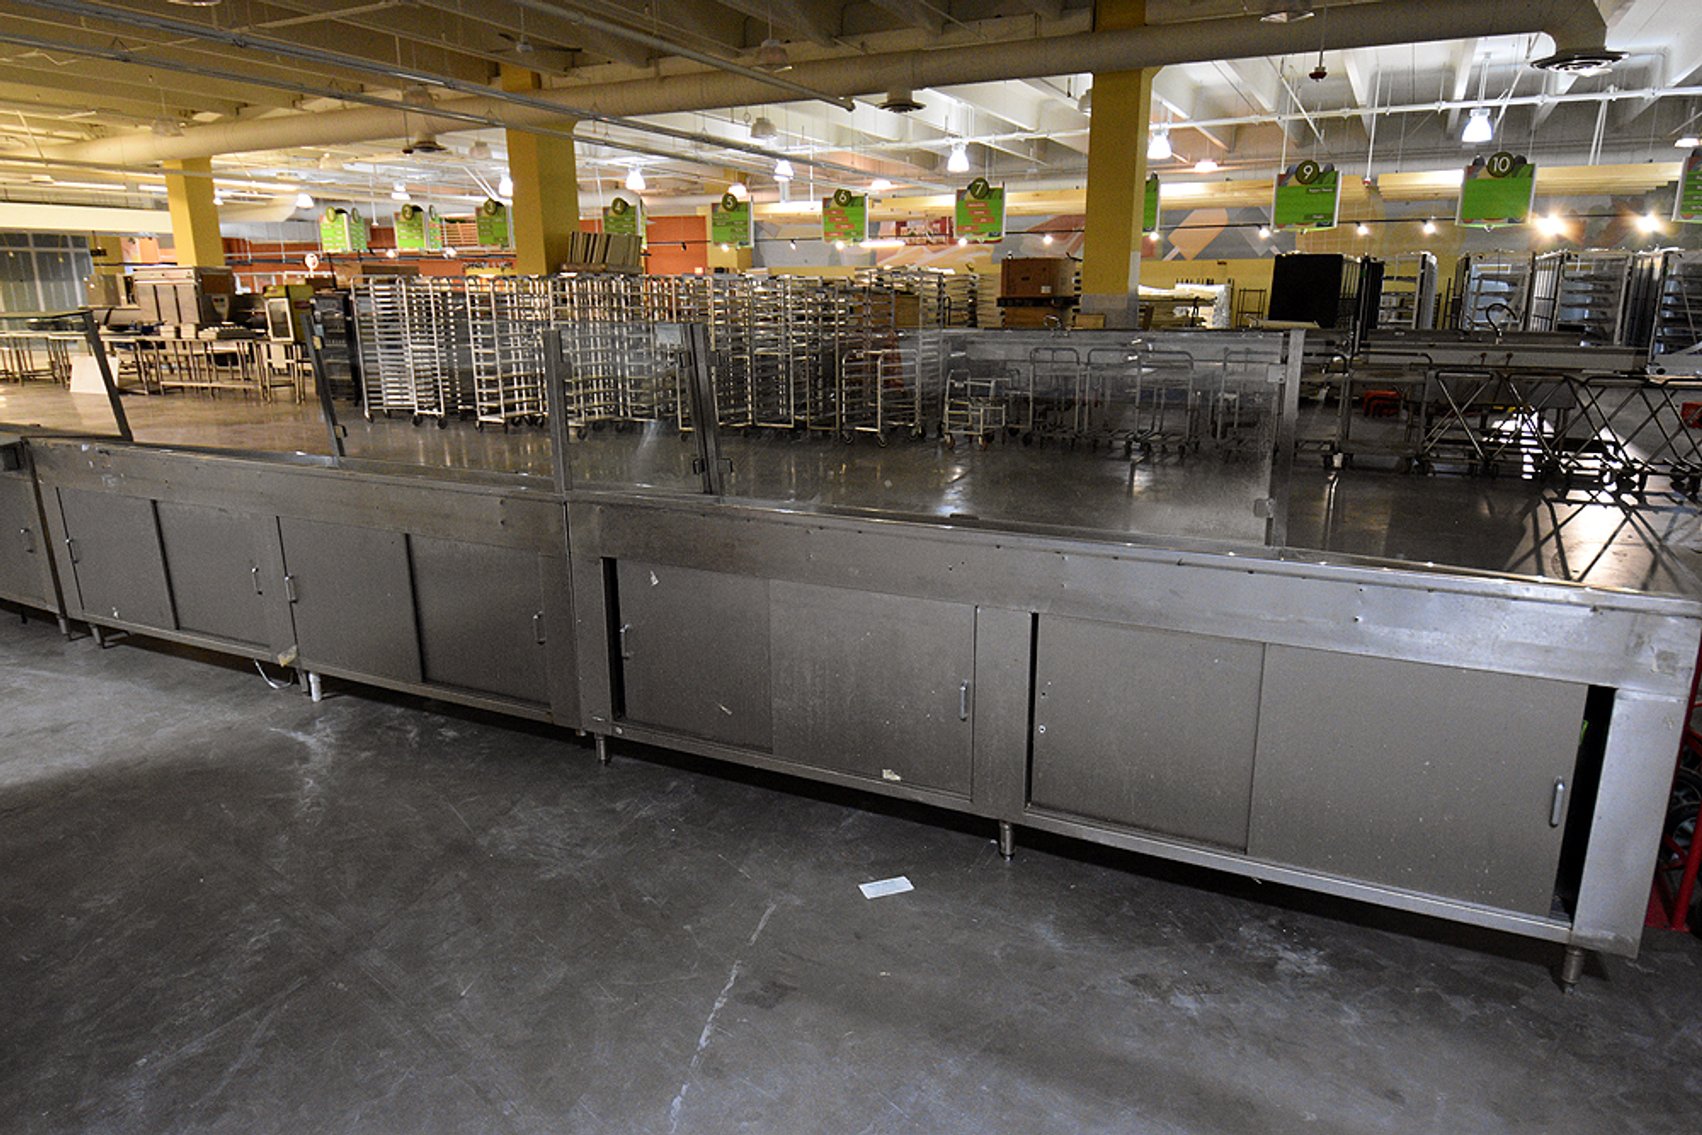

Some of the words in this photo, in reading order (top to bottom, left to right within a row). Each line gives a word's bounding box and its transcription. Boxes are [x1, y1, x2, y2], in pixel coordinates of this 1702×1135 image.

[1491, 157, 1510, 172] 10
[1303, 165, 1313, 180] 9
[975, 182, 984, 196] 7
[726, 195, 733, 208] 5
[838, 191, 847, 203] 6
[615, 202, 621, 212] 4
